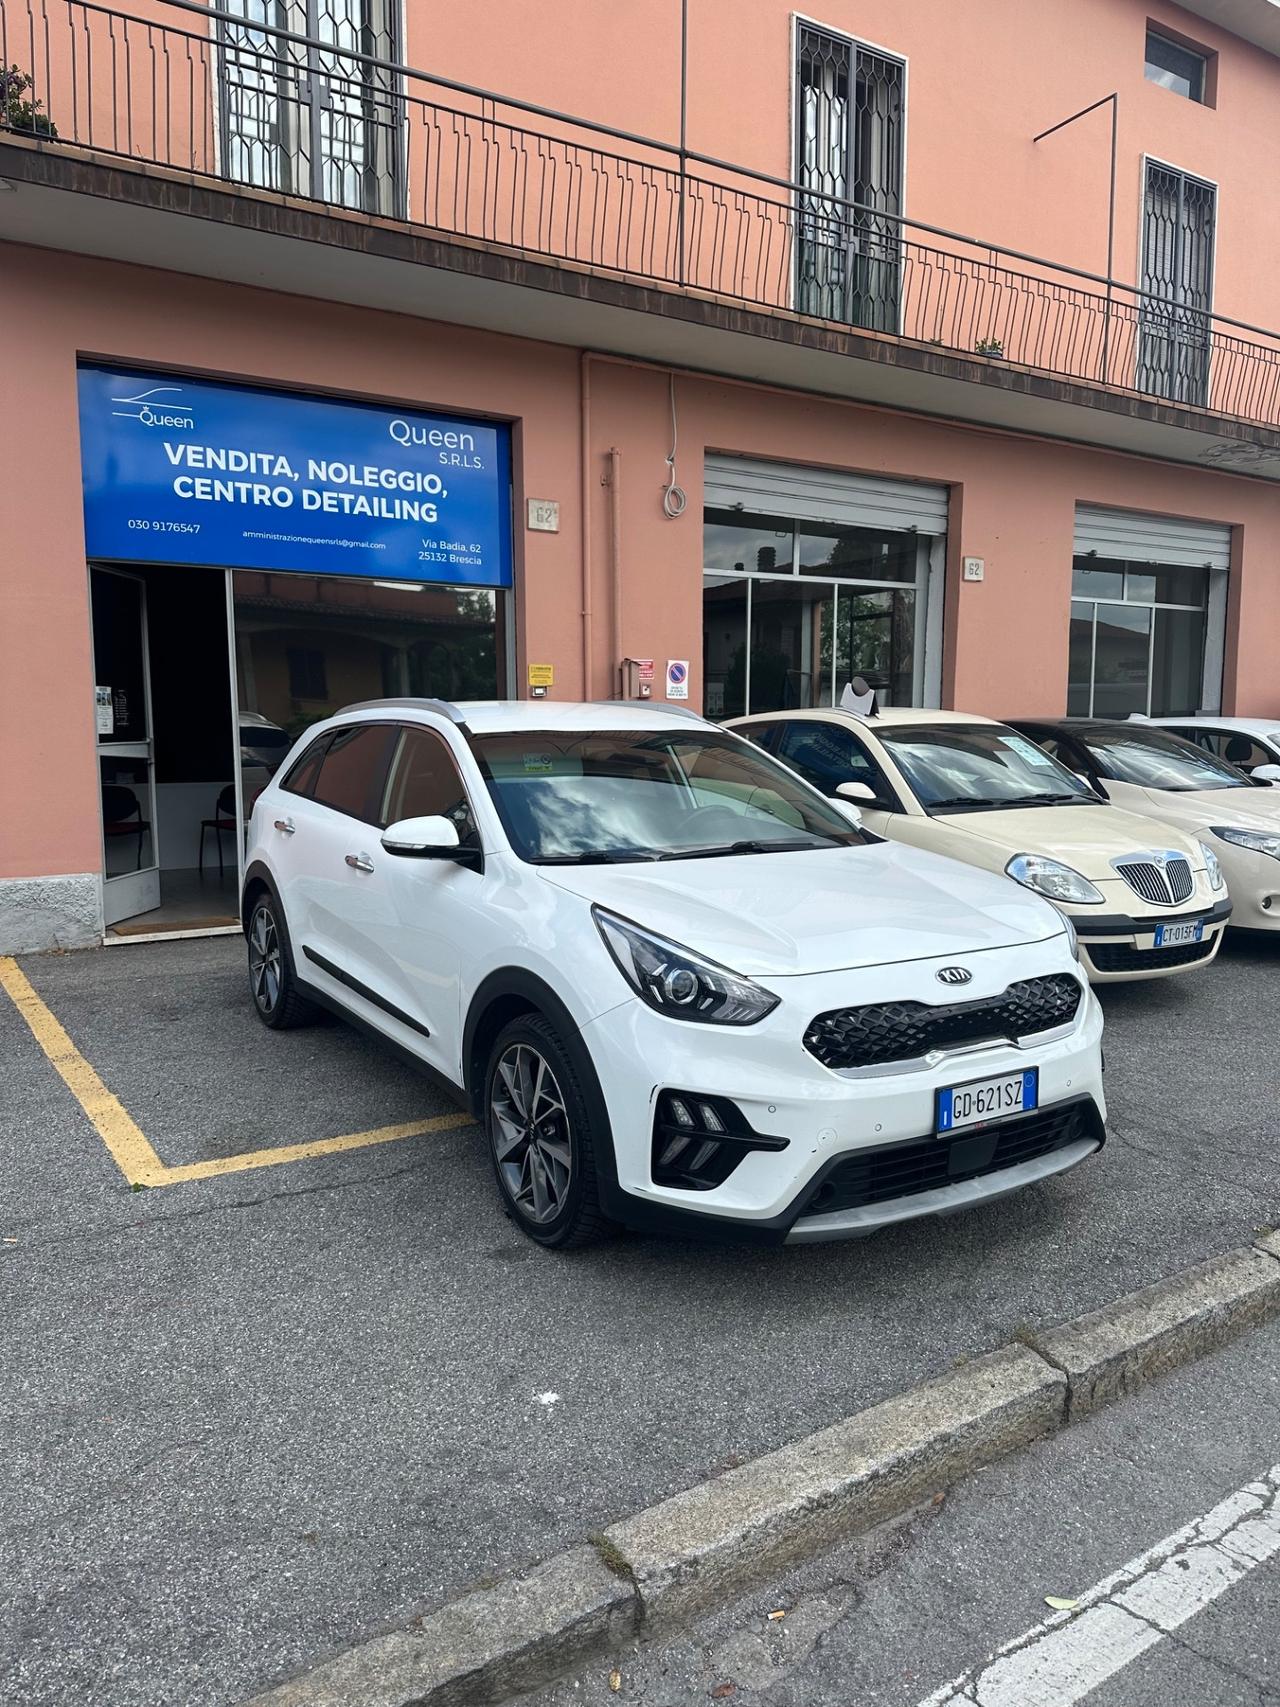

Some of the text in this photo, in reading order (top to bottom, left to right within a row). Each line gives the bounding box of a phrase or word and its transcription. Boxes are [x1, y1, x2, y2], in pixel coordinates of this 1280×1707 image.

[139, 410, 194, 429] Queen
[389, 420, 474, 451] Queen
[439, 452, 485, 469] S.R.L.S.
[163, 442, 448, 498] VENDITA, NOLEGGIO,
[173, 475, 438, 523] CENTRO DETAILING
[128, 519, 200, 534] 030 9176547
[242, 530, 386, 550] amministrazionequeensrls@gmail.com
[422, 539, 481, 553] Via Badia, 62
[418, 551, 482, 565] 25132 Brescia
[940, 968, 971, 982] KIA
